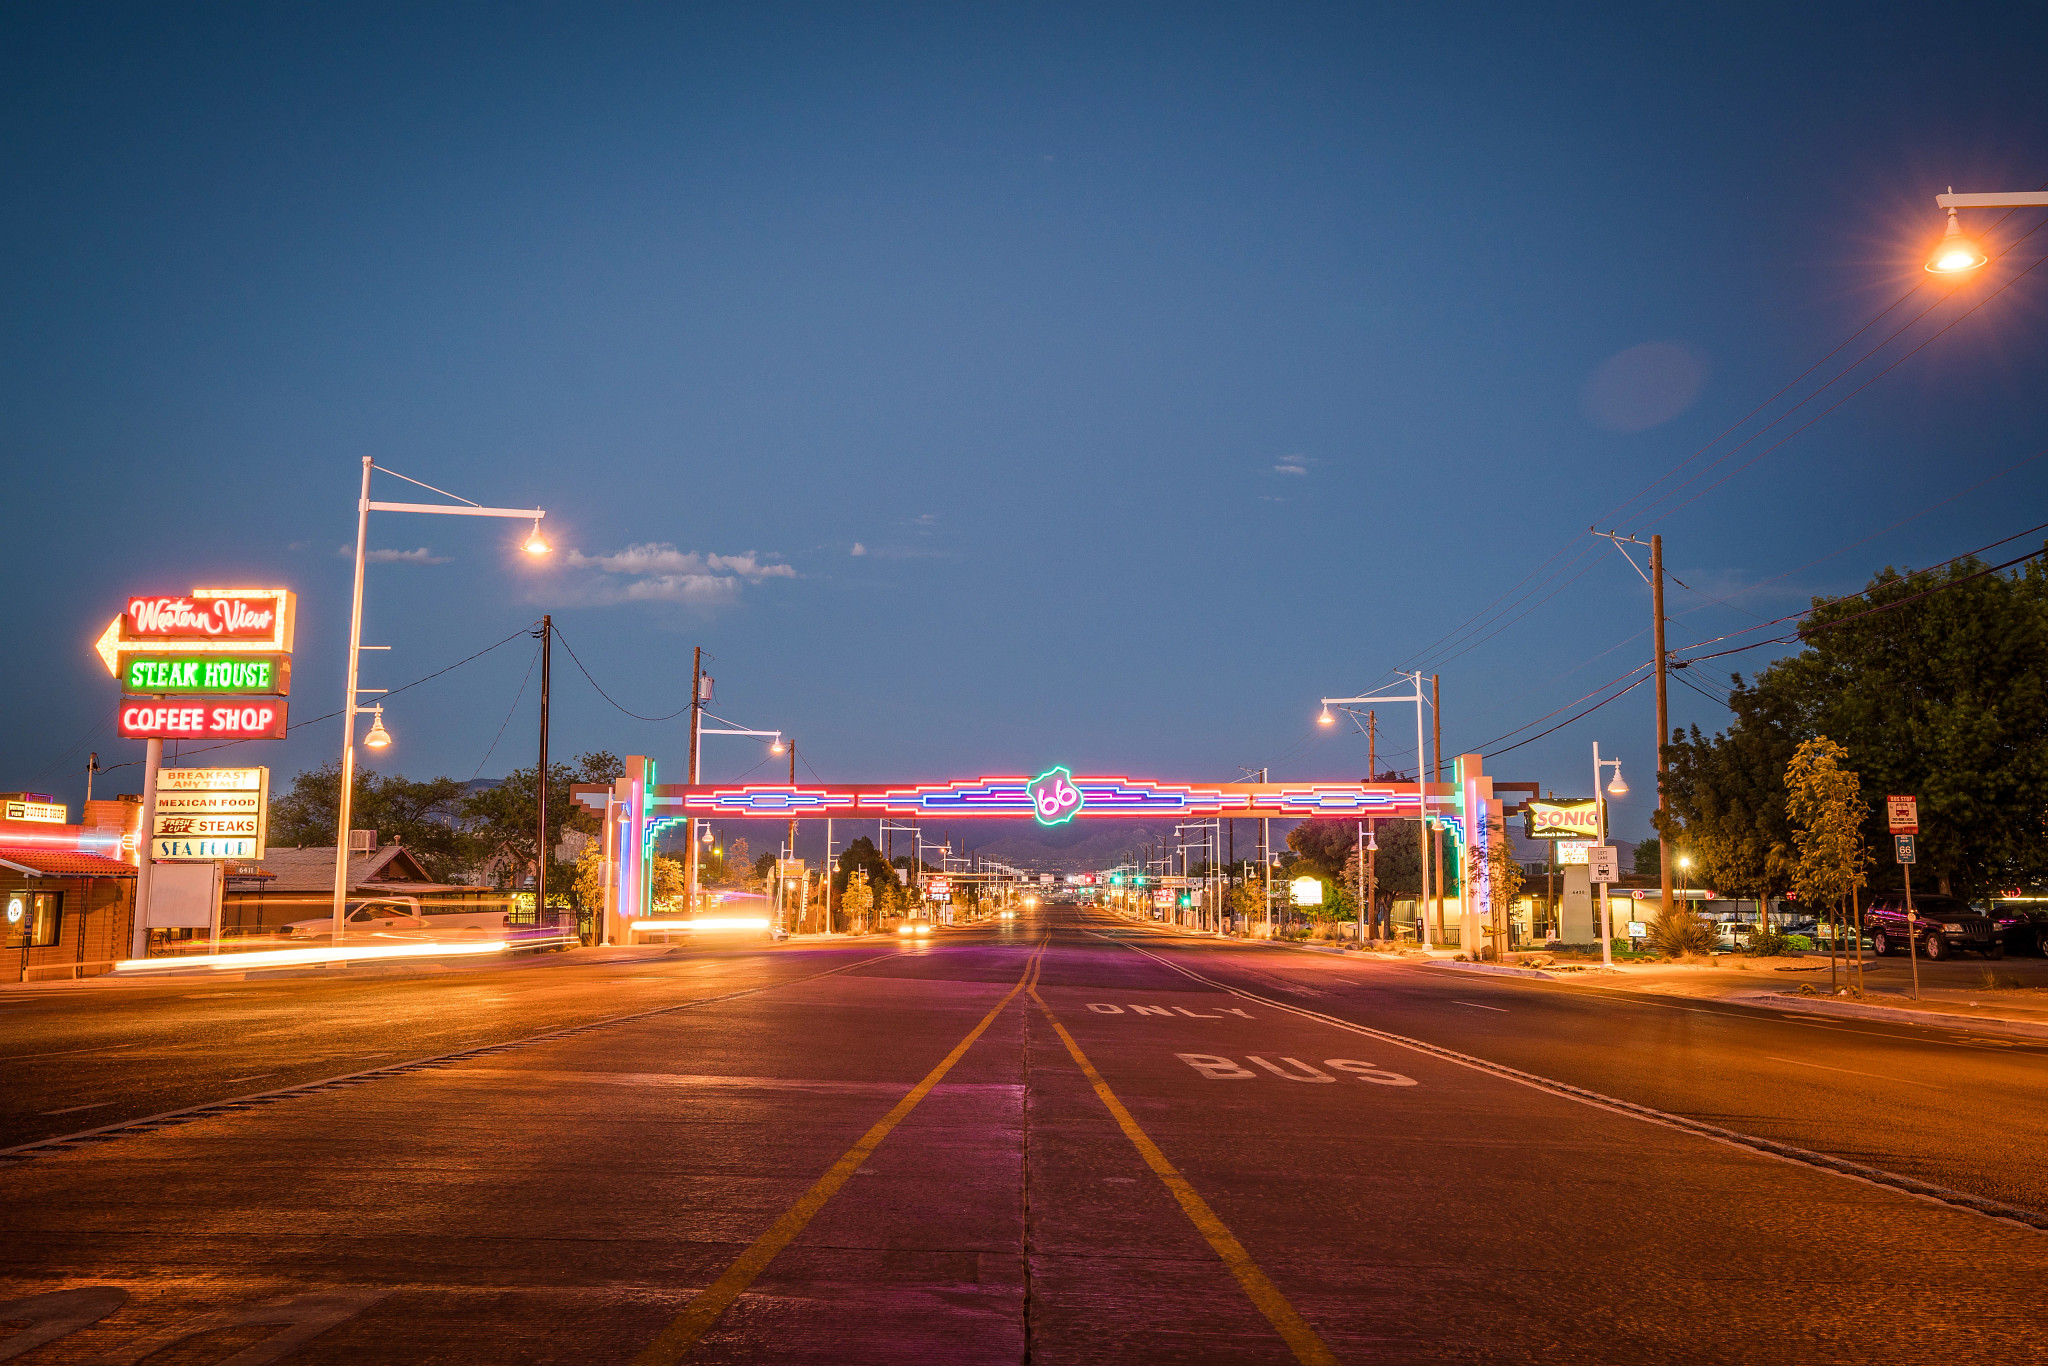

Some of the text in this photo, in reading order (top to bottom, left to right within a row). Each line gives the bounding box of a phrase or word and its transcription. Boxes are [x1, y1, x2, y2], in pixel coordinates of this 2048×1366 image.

[130, 599, 273, 633] Western View
[131, 661, 271, 688] STEAK HOUSE
[124, 708, 273, 731] COFFEE SHOP
[168, 771, 249, 780] BREAKFAST
[173, 780, 201, 788] ANY
[158, 799, 256, 807] MEXICAN FOOD
[1038, 779, 1077, 815] 66
[26, 806, 65, 819] COFFEE SHOP
[1536, 811, 1598, 826] SONIC
[165, 818, 191, 827] FRESH
[199, 820, 255, 832] STEAKS
[161, 841, 248, 857] SEA FOOD
[1899, 845, 1912, 854] 66
[801, 881, 809, 922] BEER
[1086, 1003, 1257, 1020] ONLY
[1174, 1053, 1419, 1087] BUS
